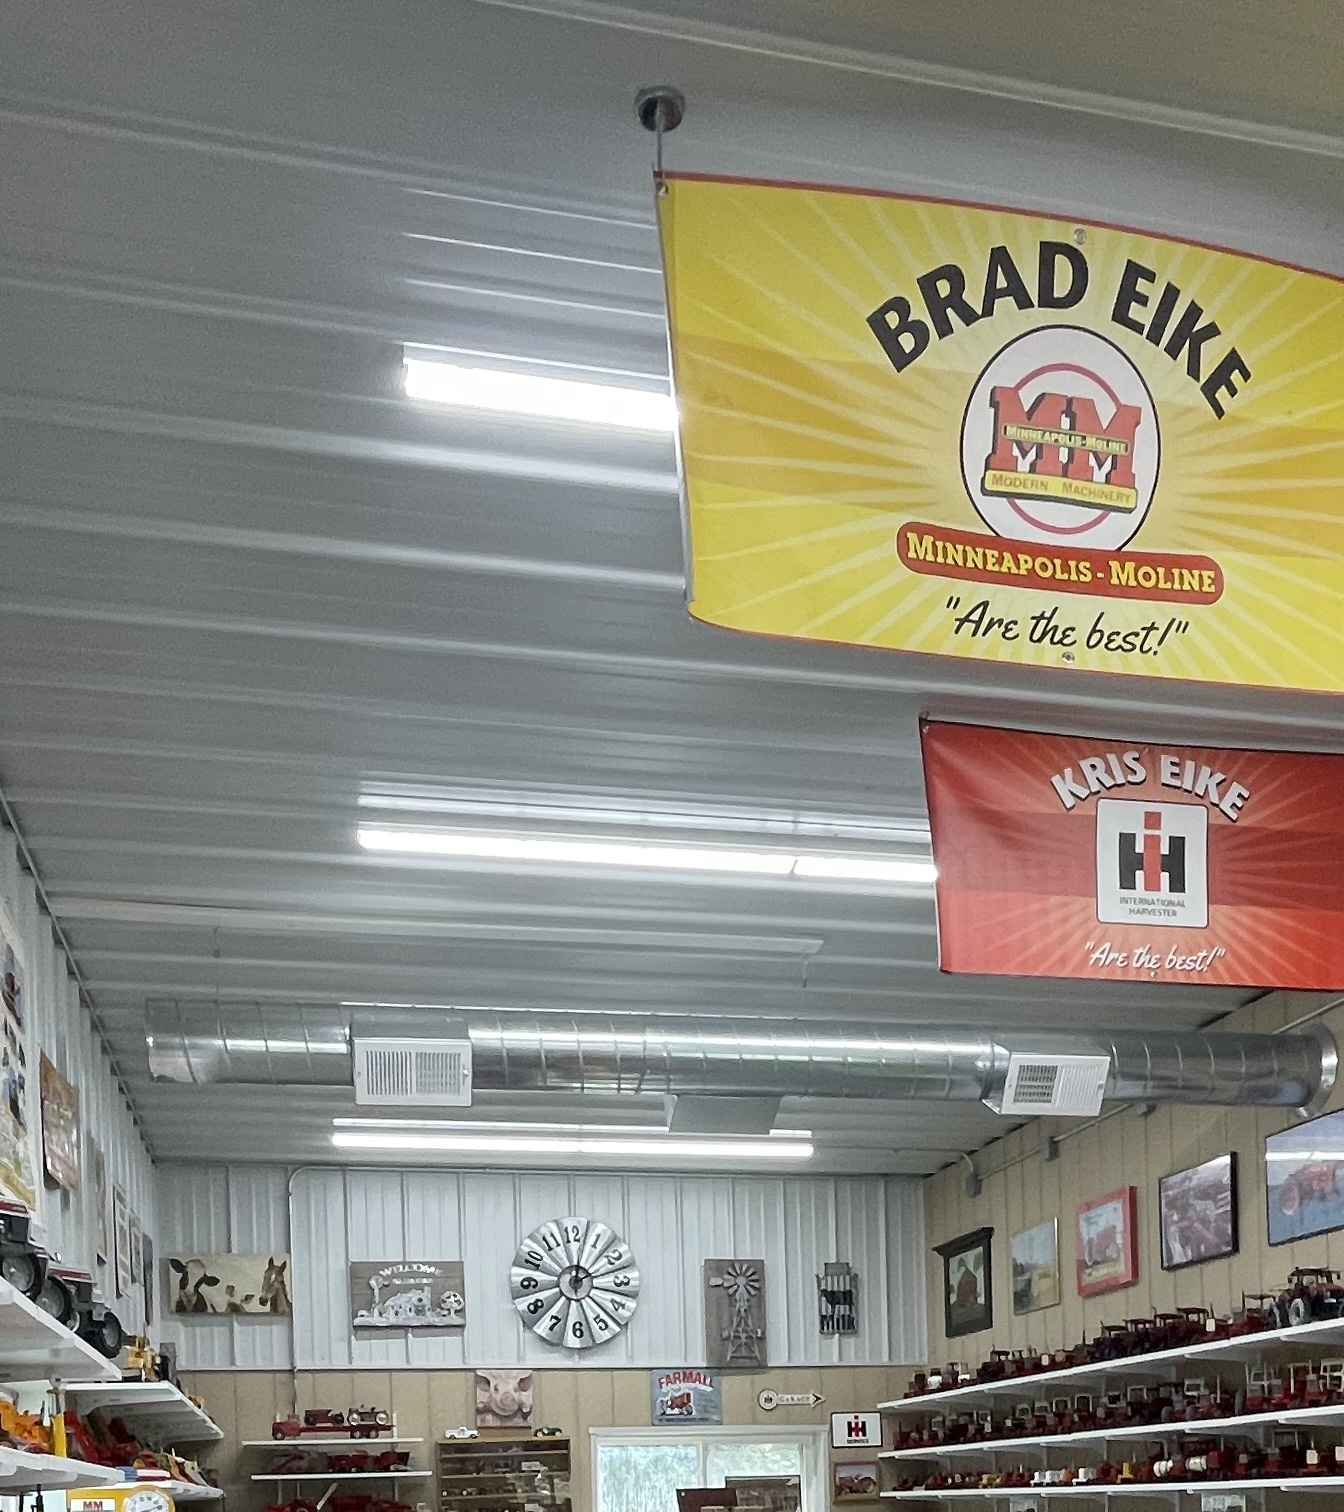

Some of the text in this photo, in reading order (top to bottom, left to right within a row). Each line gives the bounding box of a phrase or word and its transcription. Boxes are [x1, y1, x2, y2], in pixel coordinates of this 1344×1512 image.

[866, 240, 1253, 420] BRAD EIKE
[991, 474, 1131, 504] MODERN MACHINERY
[945, 596, 1190, 656] "Are the best!"
[1051, 751, 1251, 823] KRIS EIKE
[1119, 896, 1186, 908] INTERNATIONAL
[1128, 907, 1177, 917] HARVESTER
[1085, 941, 1226, 972] "Are the best!"
[542, 1231, 561, 1251] 11
[564, 1225, 581, 1244] 12
[591, 1233, 601, 1250] 1
[524, 1250, 544, 1270] 10
[604, 1249, 623, 1265] 2
[379, 1263, 443, 1277] WELCOME
[520, 1276, 538, 1289] 9
[613, 1275, 631, 1287] 3
[527, 1298, 545, 1315] 8
[609, 1298, 626, 1312] 4
[548, 1315, 562, 1332] 7
[572, 1321, 584, 1339] 6
[593, 1314, 609, 1331] 5
[658, 1369, 714, 1389] FARMALL
